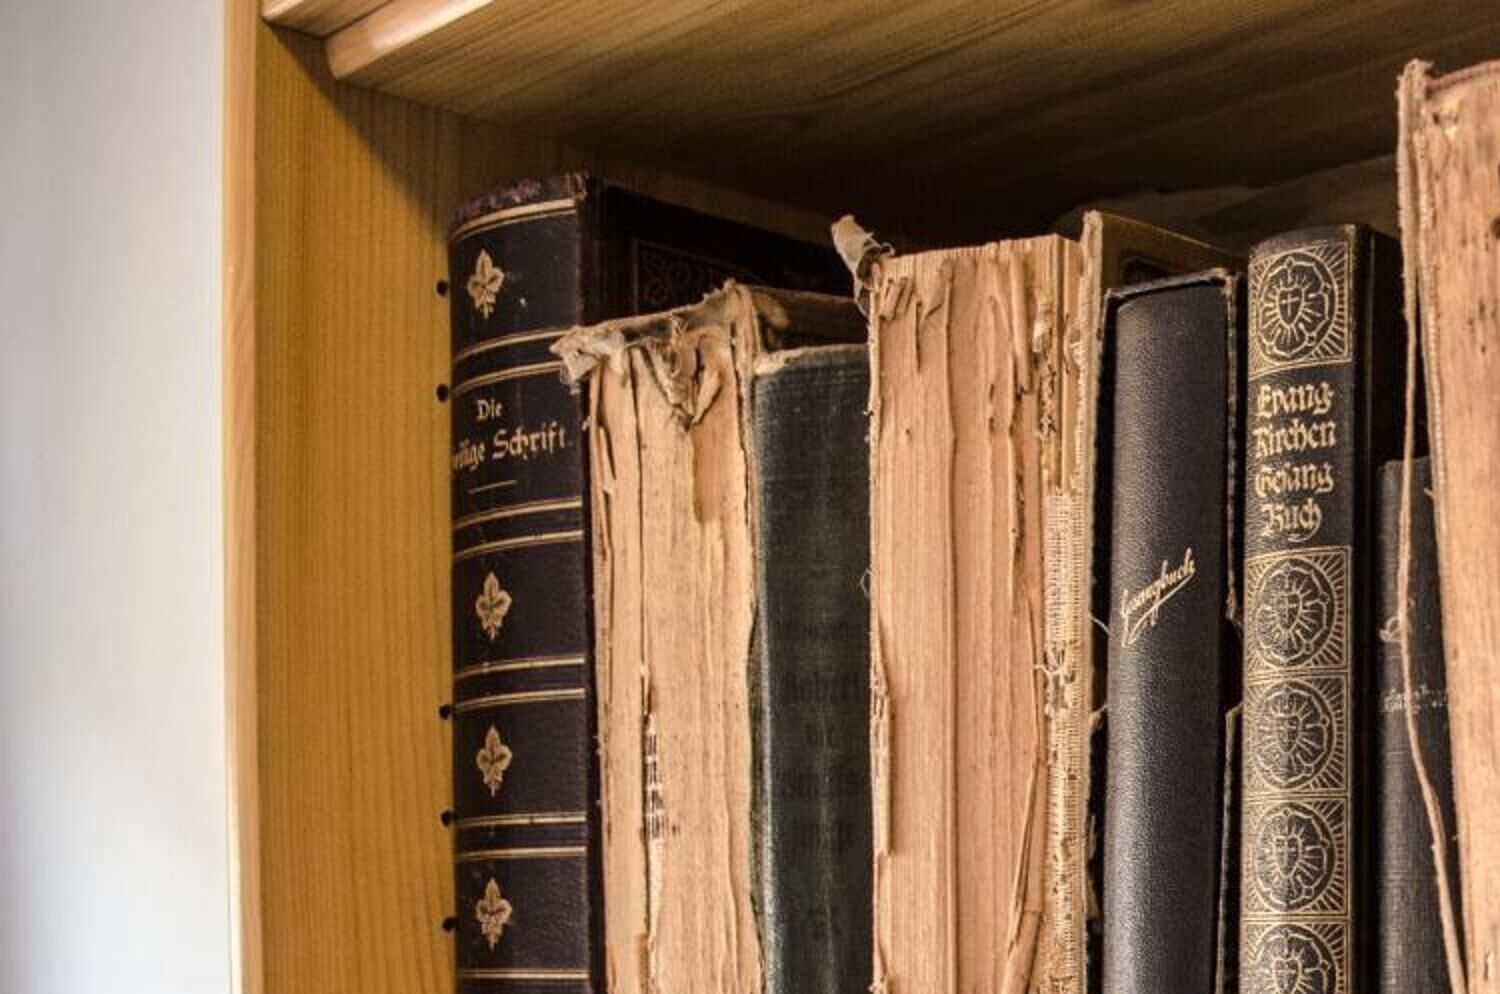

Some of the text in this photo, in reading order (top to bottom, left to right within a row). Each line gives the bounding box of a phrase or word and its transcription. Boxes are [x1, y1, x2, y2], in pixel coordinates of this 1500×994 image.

[476, 399, 502, 421] Die
[1252, 418, 1337, 458] Kirchen
[1261, 498, 1322, 542] Buch
